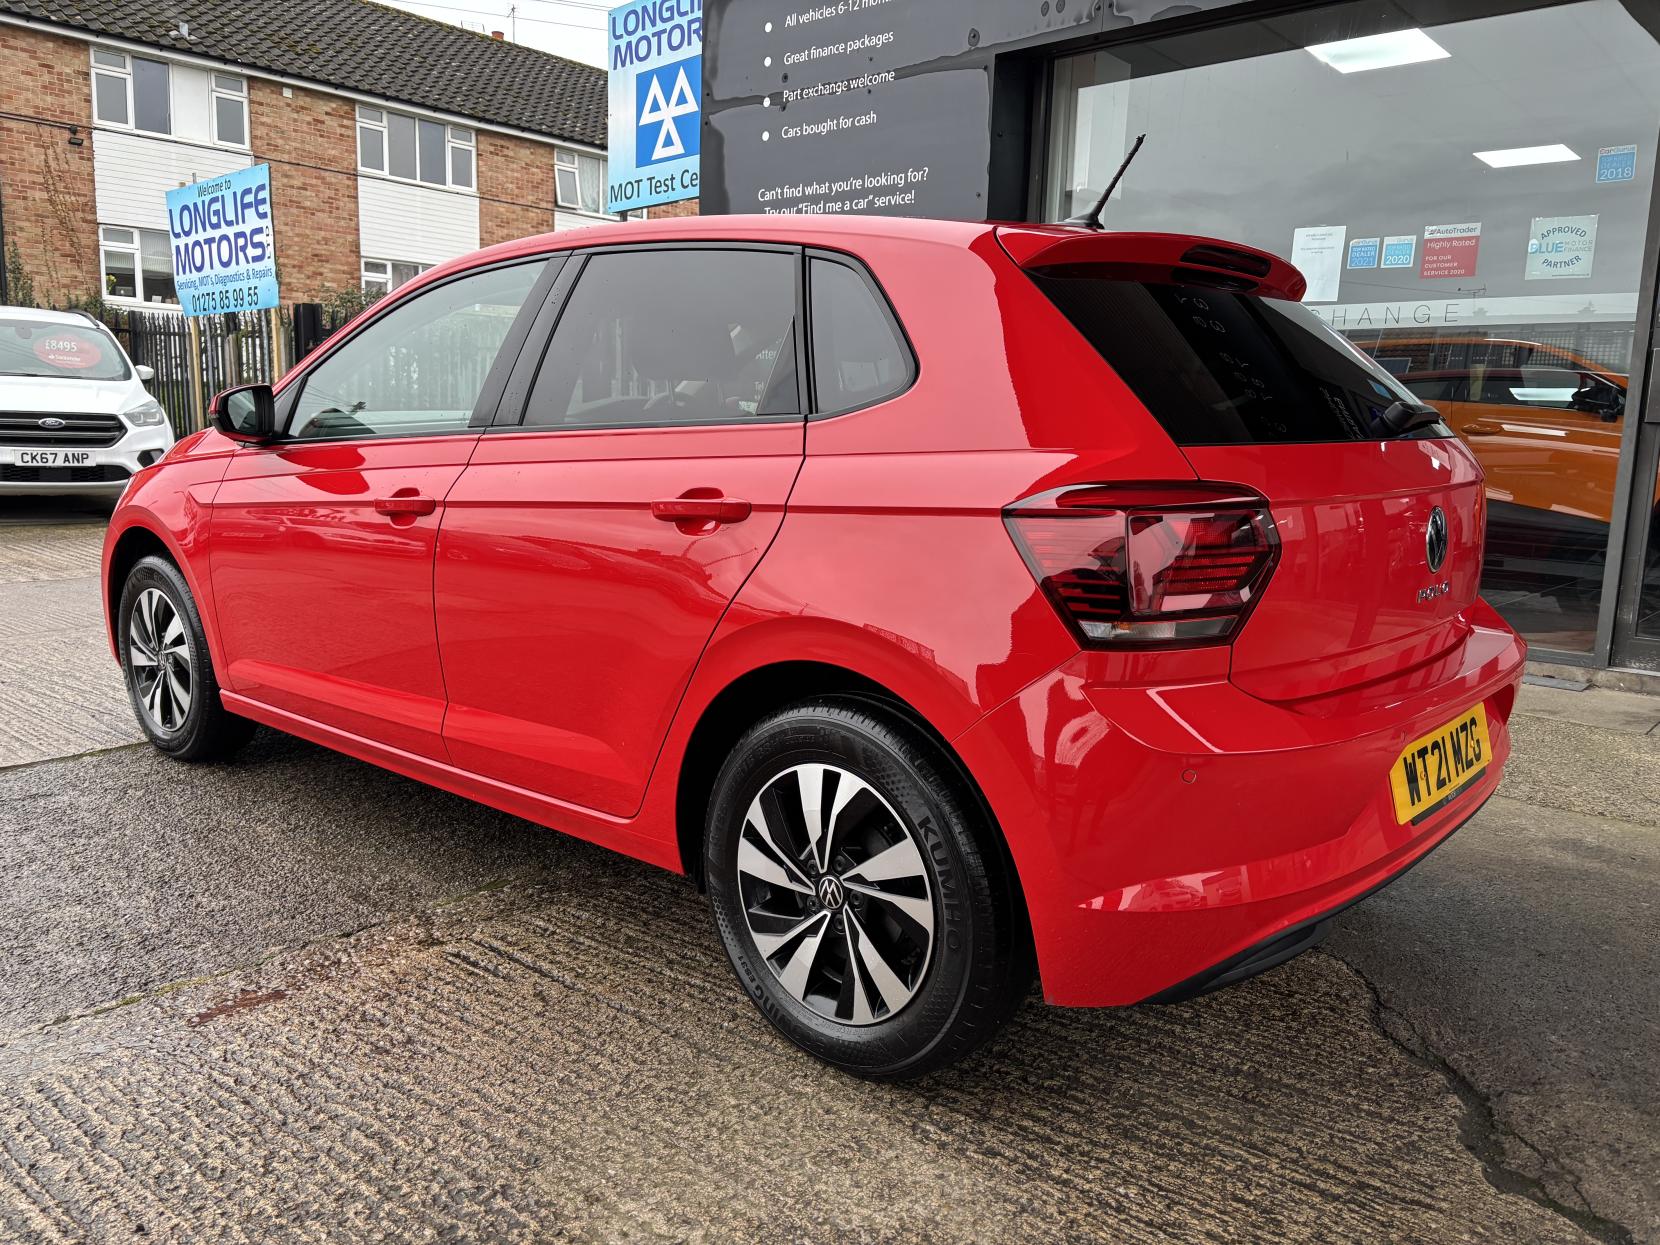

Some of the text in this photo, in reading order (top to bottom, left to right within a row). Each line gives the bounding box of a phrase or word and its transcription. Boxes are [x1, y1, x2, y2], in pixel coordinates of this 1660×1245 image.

[785, 13, 797, 28] All
[799, 5, 836, 24] vehicles
[838, 0, 860, 14] 6-12
[783, 31, 894, 65] Great finance packages
[783, 71, 895, 102] Part exchange welcome
[781, 110, 877, 138] Cars bought for cash
[758, 167, 929, 201] Can't find what you're looking for?
[1599, 167, 1632, 179] 2018
[197, 179, 232, 198] Welcome to
[610, 179, 643, 203] MOT
[646, 173, 676, 195] Test
[168, 183, 268, 239] LONGLIFE
[826, 202, 842, 213] me
[844, 201, 850, 210] a
[874, 190, 915, 208] service!
[1437, 226, 1477, 235] AutoTrader
[1541, 226, 1587, 240] APPROVED
[175, 226, 266, 276] MOTORS
[1427, 239, 1476, 250] Highly Rated
[1386, 255, 1410, 264] 2020
[1541, 255, 1582, 269] PARTNER
[176, 279, 199, 291] Servicing,
[214, 270, 245, 286] Diagnostics
[246, 270, 251, 280] &
[252, 266, 272, 280] Repairs
[191, 286, 259, 312] 01275 85 99 55
[1311, 304, 1460, 326] HANGE
[45, 340, 77, 352] £8495
[20, 452, 89, 464] CK67 ANP
[1403, 735, 1451, 806] WT21
[917, 815, 961, 950] KUMHO
